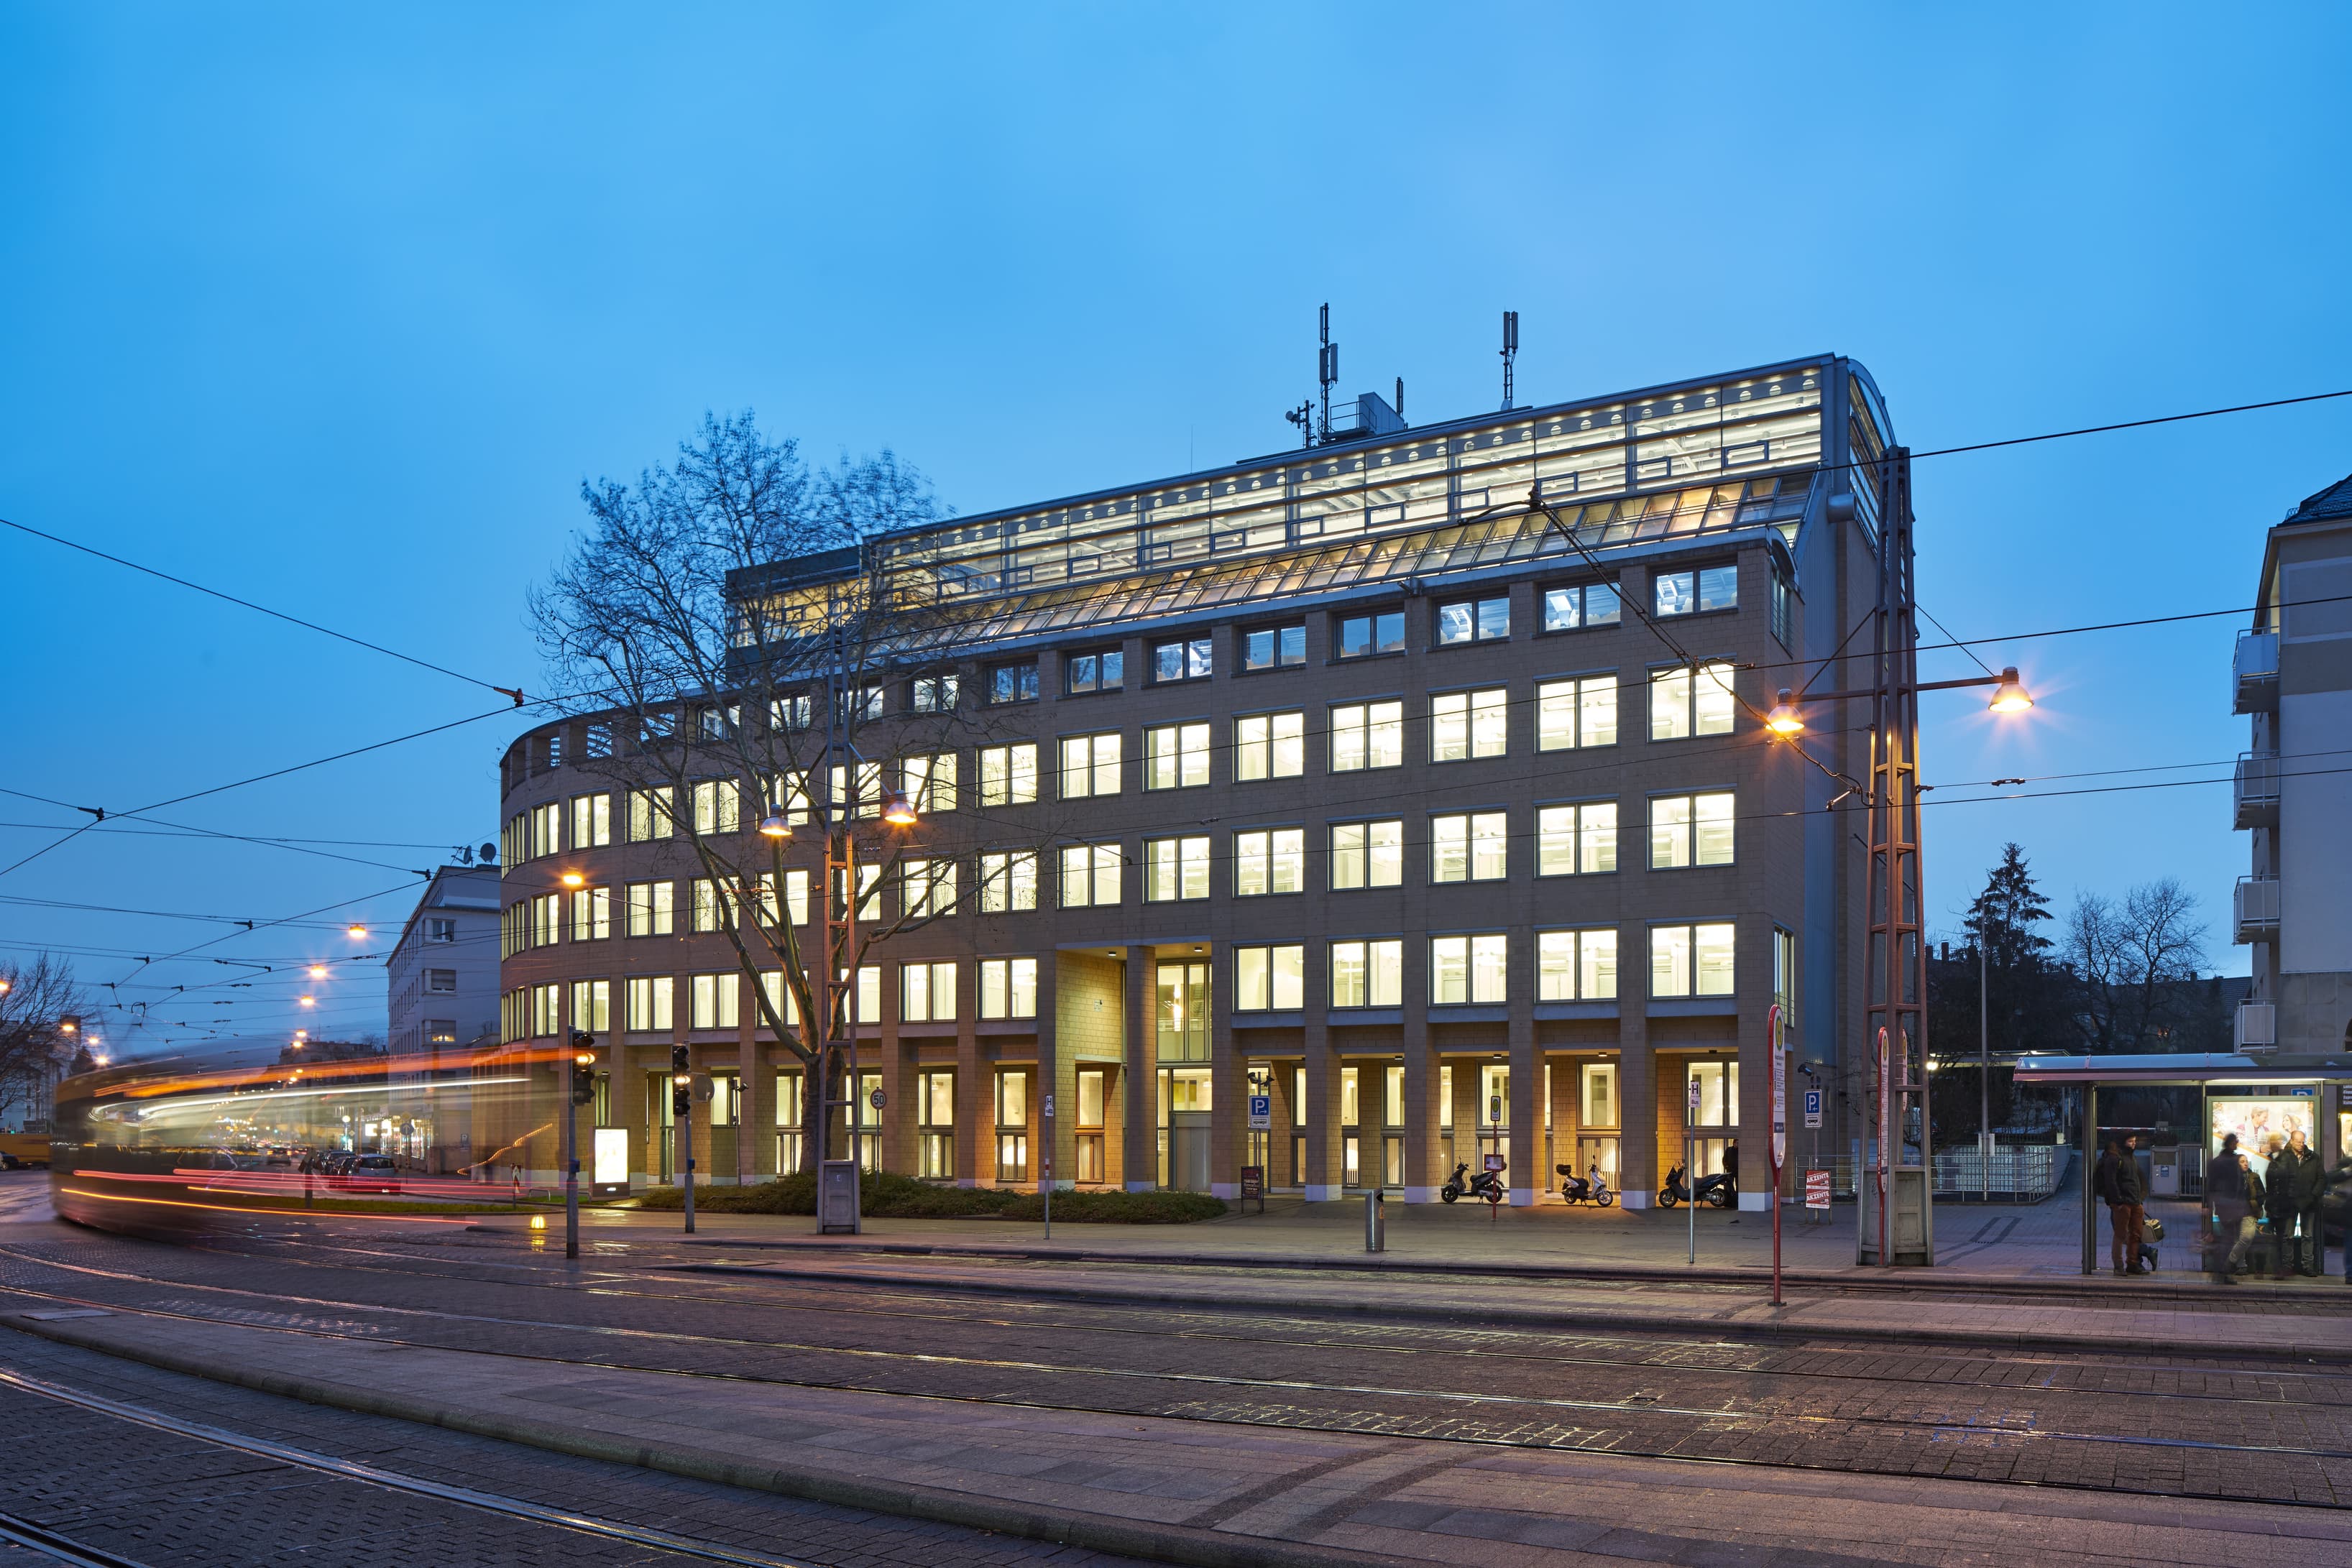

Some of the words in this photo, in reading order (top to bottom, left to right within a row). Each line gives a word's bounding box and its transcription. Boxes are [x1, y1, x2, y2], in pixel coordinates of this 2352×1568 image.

[1692, 1084, 1698, 1094] H
[873, 1094, 884, 1104] 50
[1809, 1094, 1816, 1111] P
[1255, 1099, 1265, 1114] P
[1806, 1172, 1829, 1183] AKZENTE
[1806, 1191, 1829, 1202] AKZENTE
